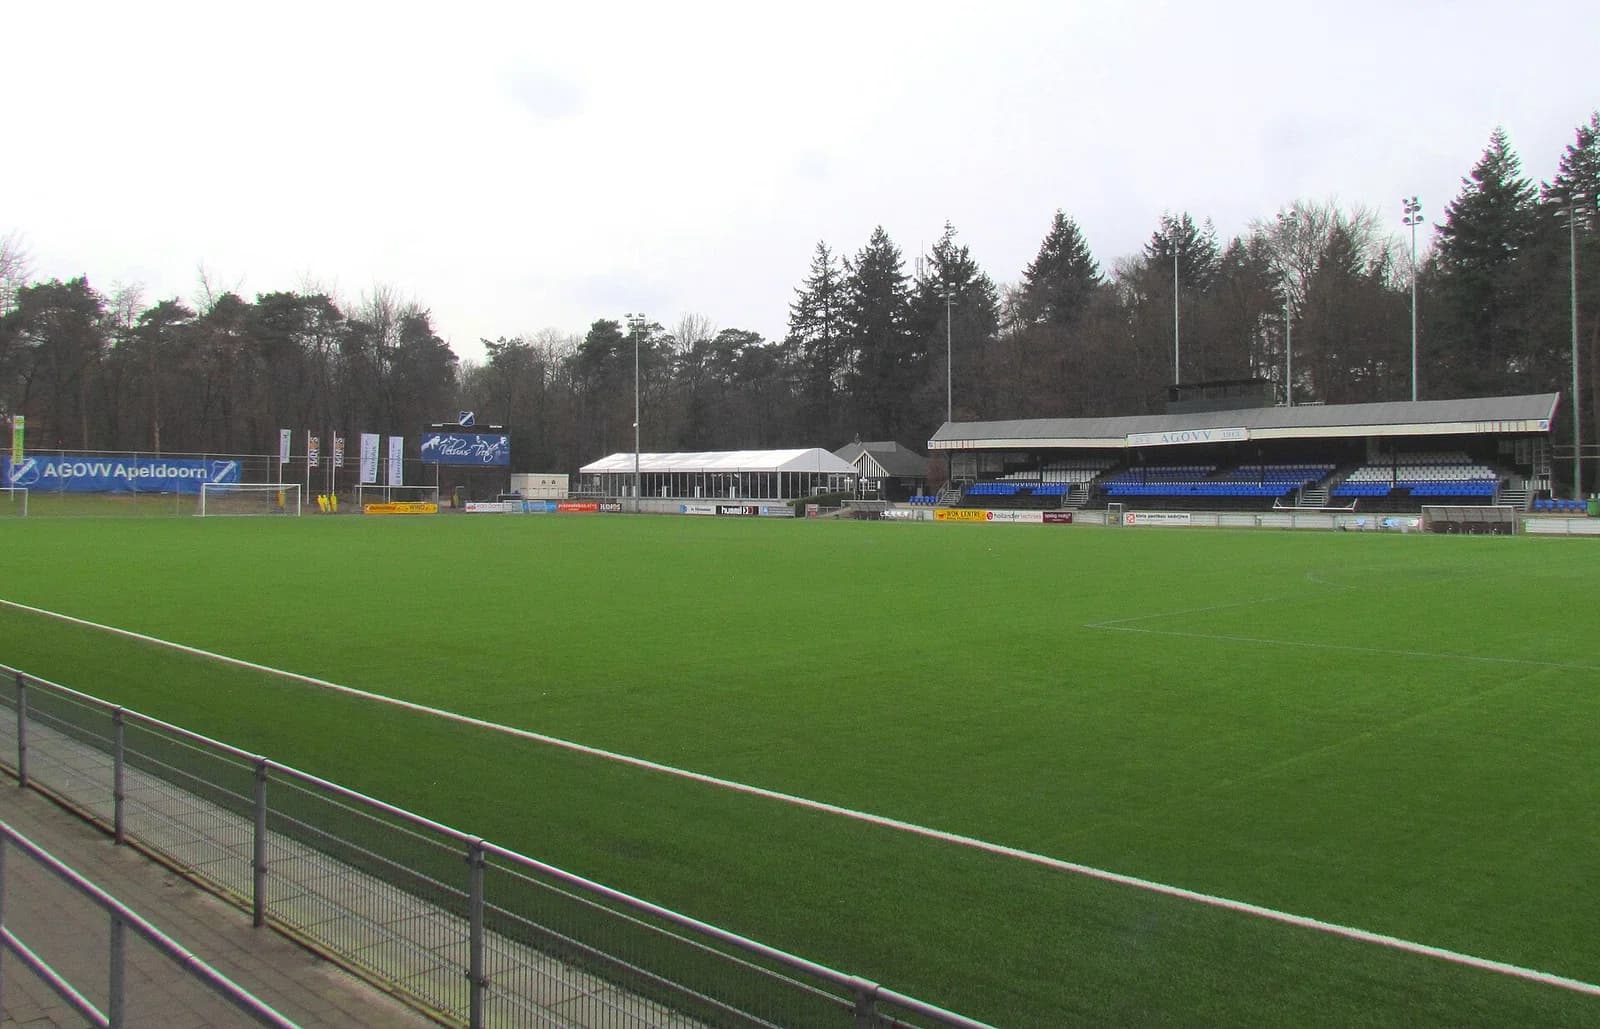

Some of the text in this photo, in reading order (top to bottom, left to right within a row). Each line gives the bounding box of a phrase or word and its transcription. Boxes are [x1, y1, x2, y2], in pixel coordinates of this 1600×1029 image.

[1161, 431, 1212, 443] AGOVV
[43, 462, 208, 481] AGOVV Apeldoorn
